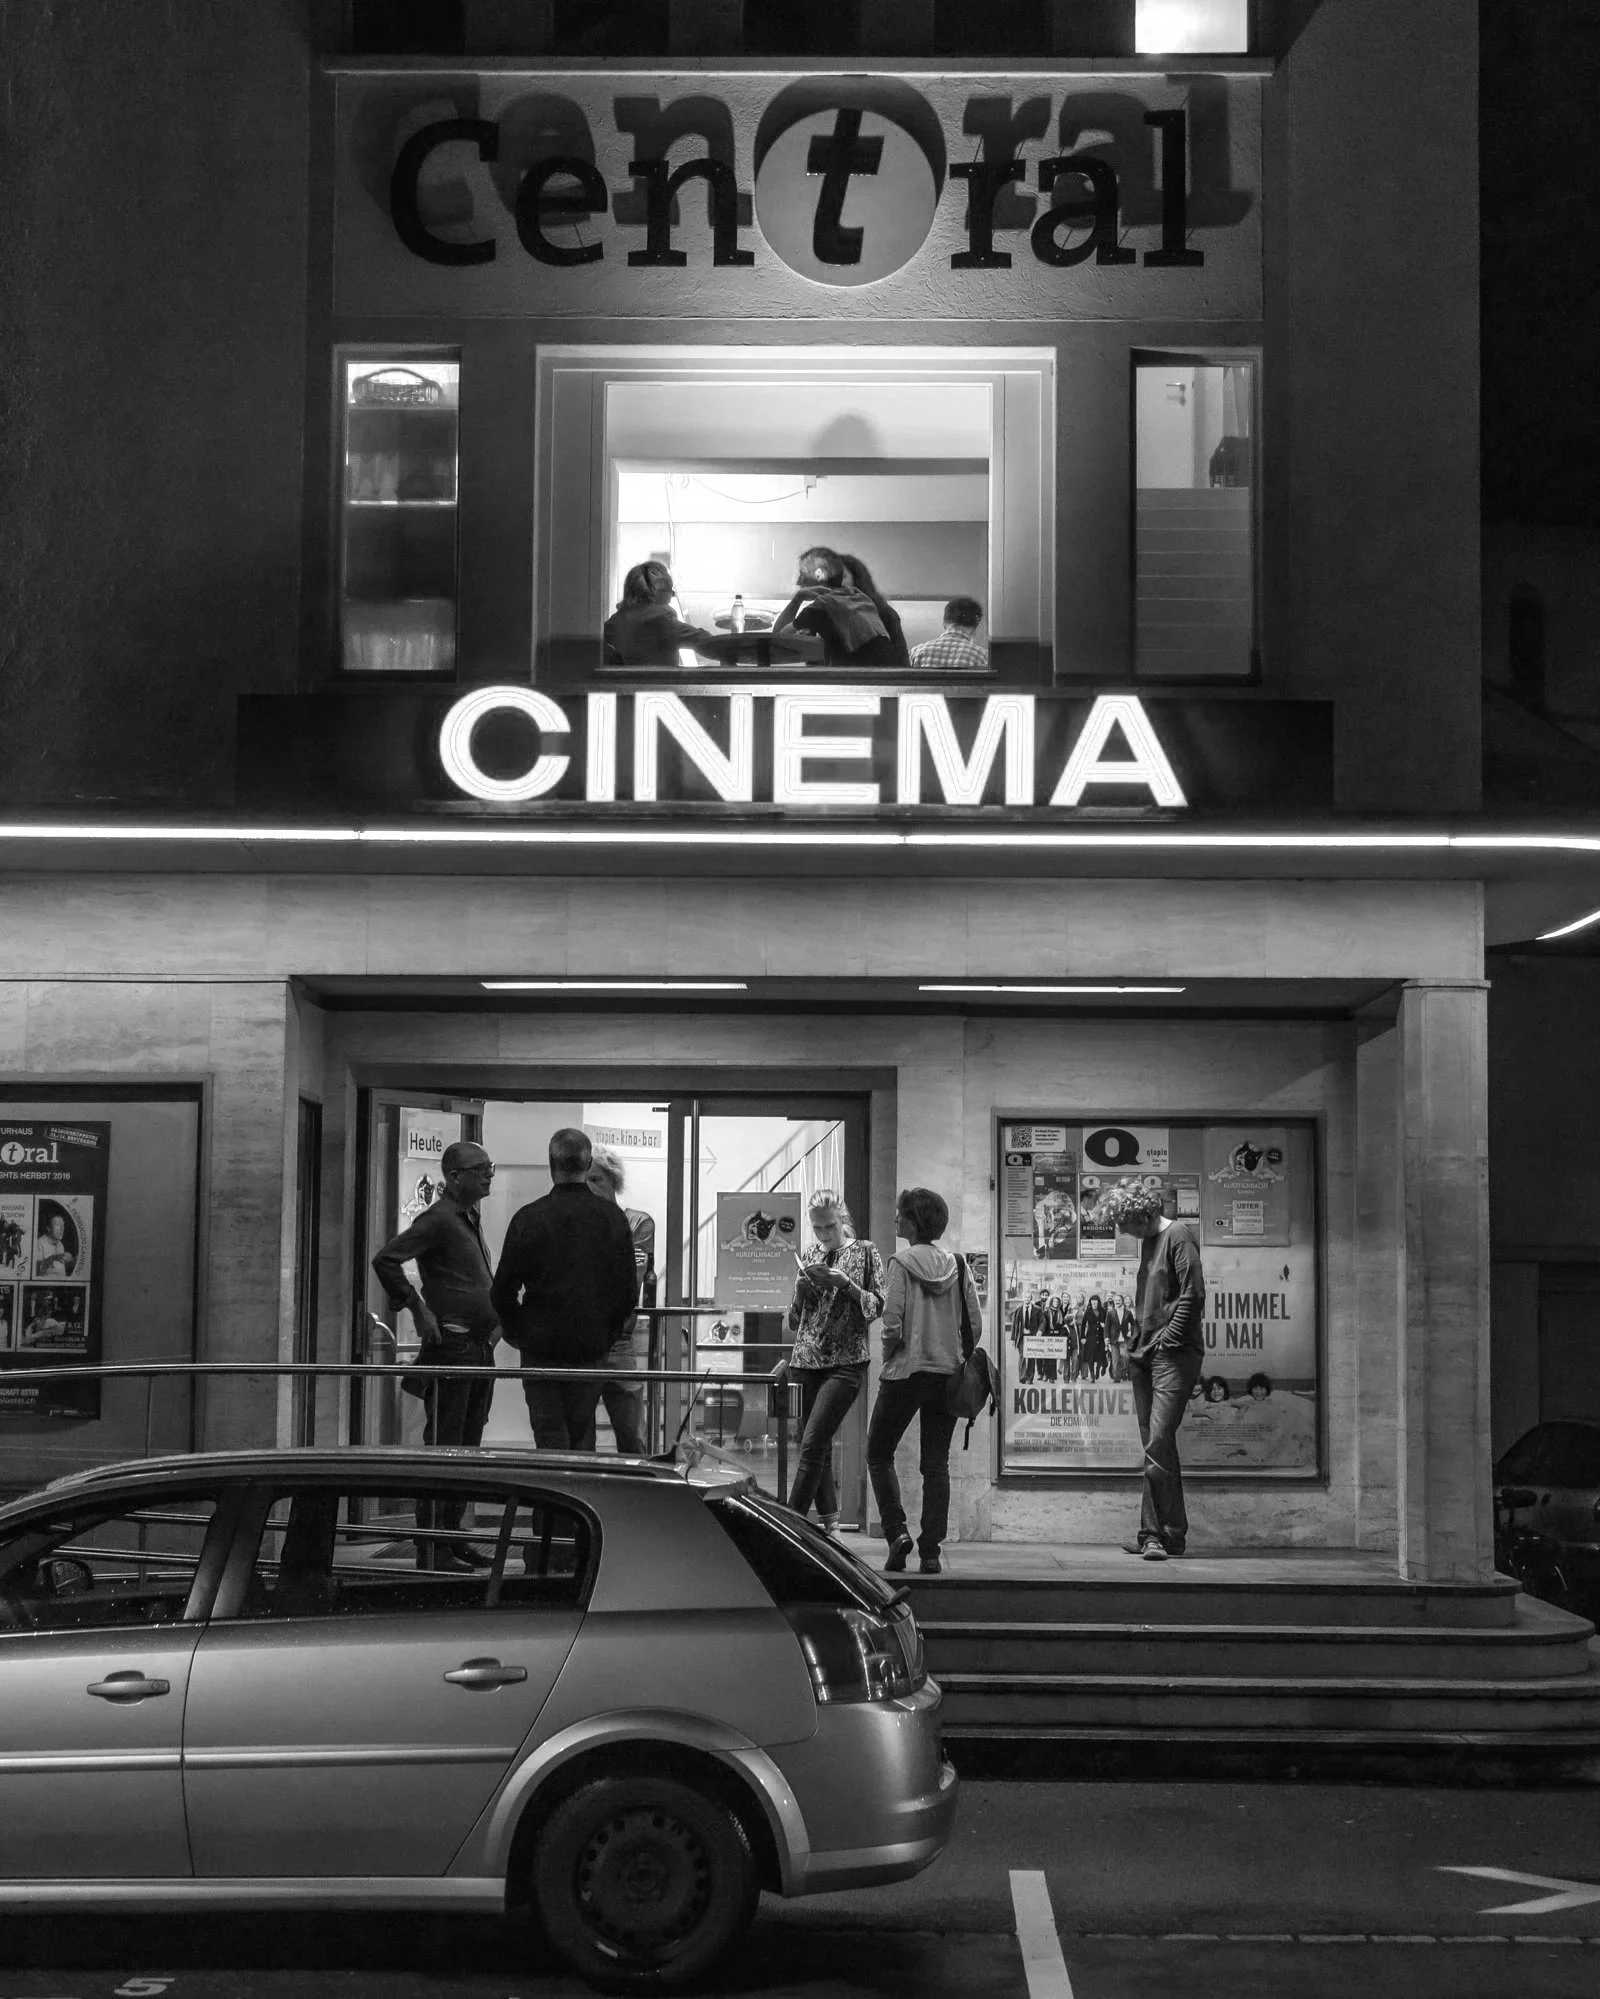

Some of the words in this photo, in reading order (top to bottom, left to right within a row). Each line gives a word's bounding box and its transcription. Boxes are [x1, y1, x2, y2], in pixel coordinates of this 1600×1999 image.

[439, 685, 1188, 806] CINEMA
[410, 1132, 442, 1152] Heute
[0, 1142, 59, 1164] tral
[20, 1171, 51, 1180] HERBST
[53, 1172, 71, 1180] 2016
[1214, 1293, 1290, 1320] HIMMEL
[1226, 1322, 1263, 1349] NAH
[1050, 1416, 1062, 1427] DIE
[114, 1977, 176, 1997] 5
